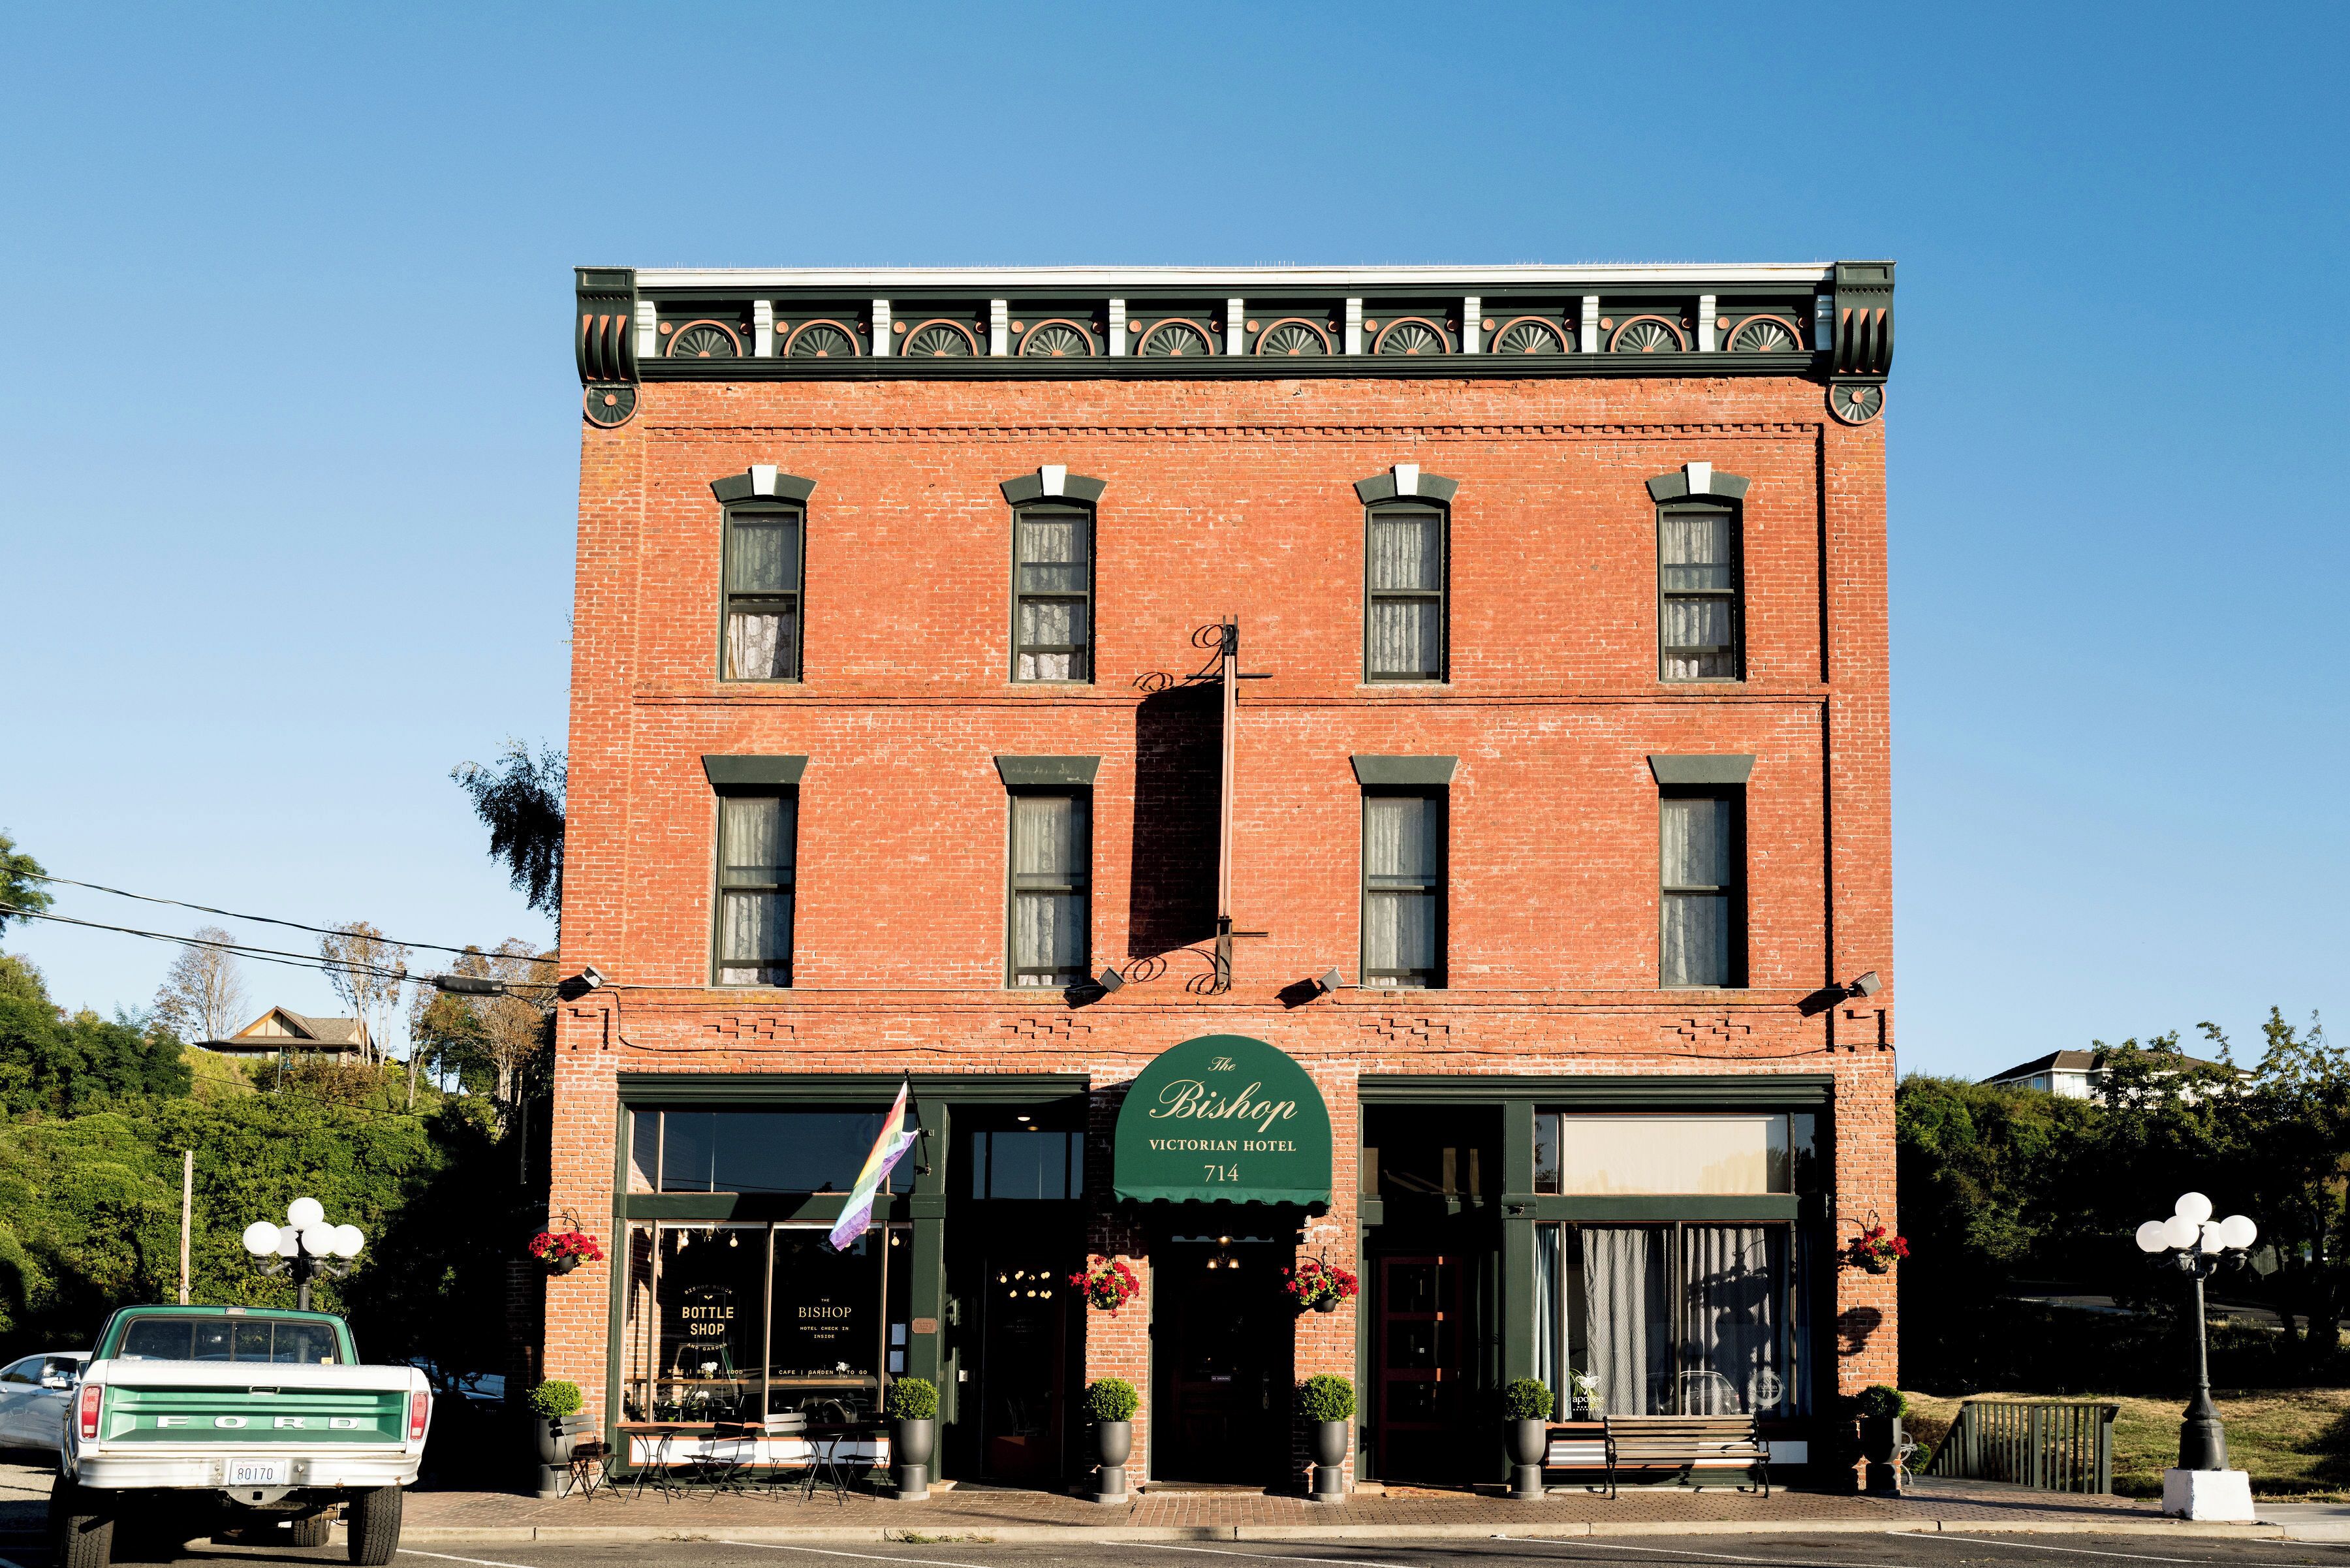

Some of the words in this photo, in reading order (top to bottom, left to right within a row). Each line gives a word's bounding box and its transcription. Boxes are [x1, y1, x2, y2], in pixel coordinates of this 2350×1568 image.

[1208, 1057, 1236, 1071] The
[1149, 1079, 1298, 1133] Bishop
[1149, 1139, 1238, 1152] VICTORIAN
[1243, 1140, 1296, 1152] HOTEL
[1204, 1163, 1239, 1182] 714
[684, 1284, 709, 1294] BISHOP
[712, 1285, 733, 1294] BLOCK
[682, 1306, 734, 1319] BOTTLE
[798, 1307, 852, 1318] BISHOP
[690, 1323, 725, 1336] SHOP
[702, 1342, 727, 1351] GARDEN
[157, 1415, 360, 1430] FORD
[238, 1467, 273, 1480] 80170
